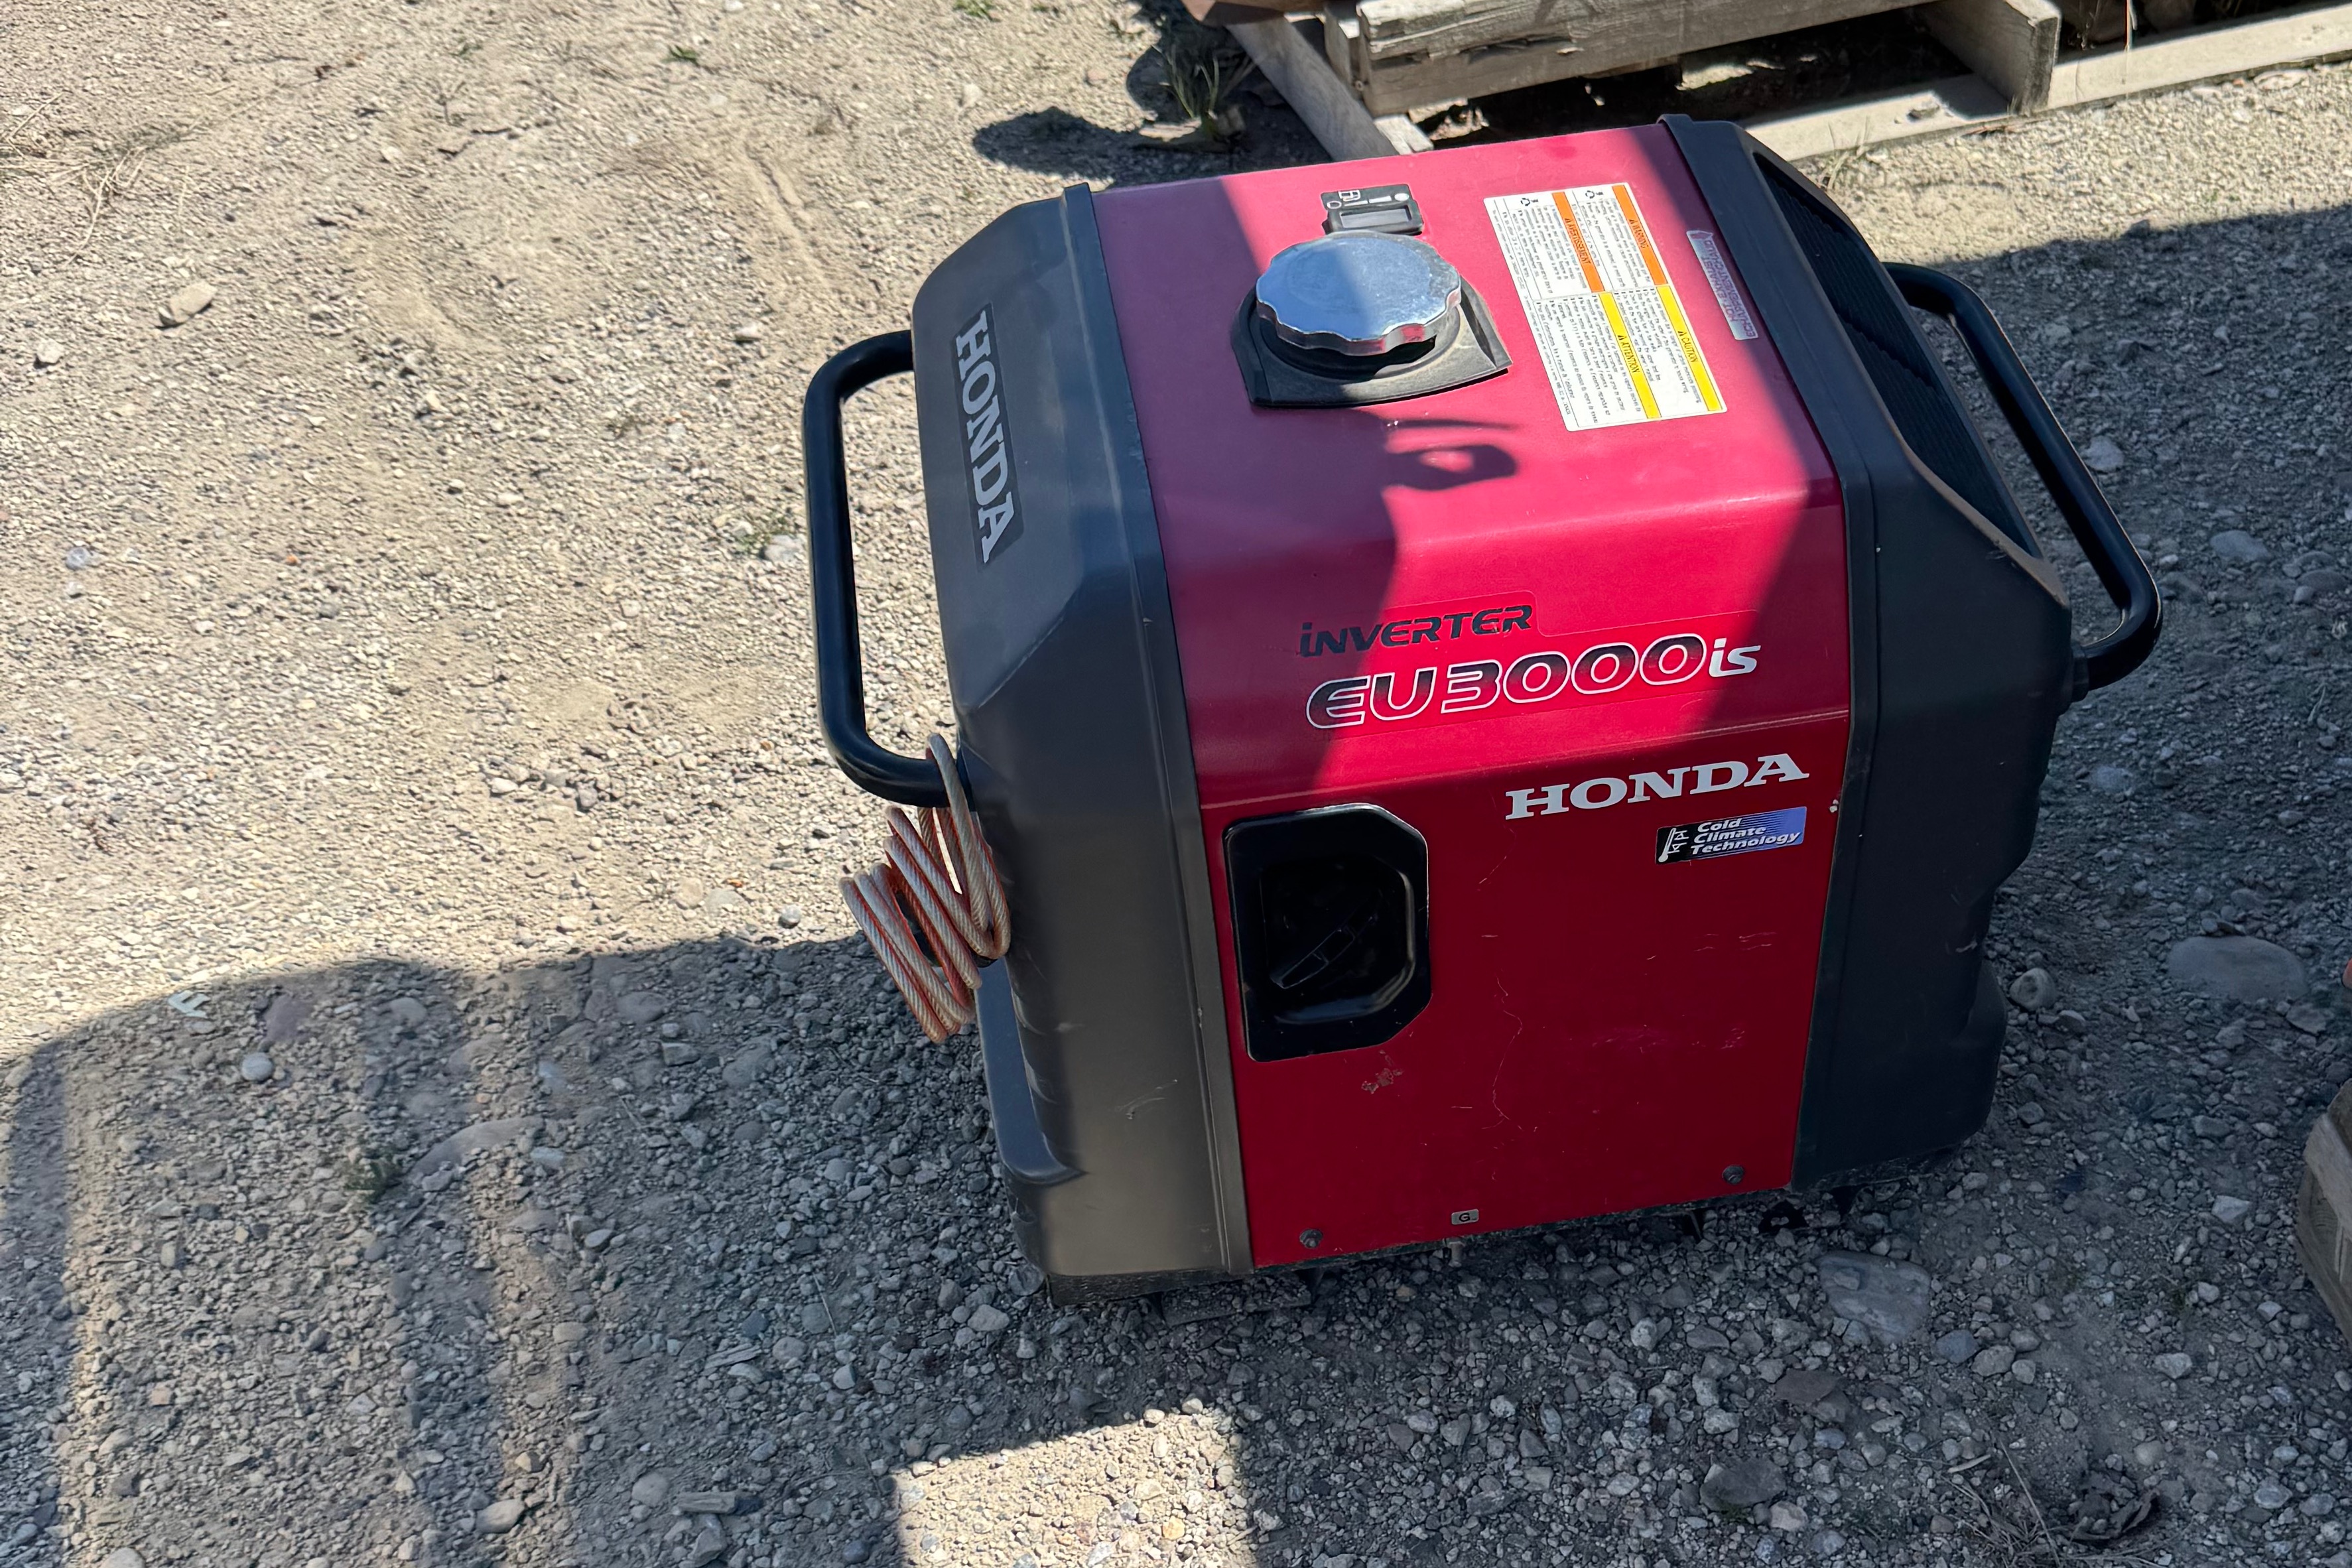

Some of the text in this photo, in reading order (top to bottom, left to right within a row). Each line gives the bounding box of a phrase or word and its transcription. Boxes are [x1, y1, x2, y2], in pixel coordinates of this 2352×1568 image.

[1620, 341, 1640, 373] ATTENTION
[1680, 337, 1699, 362] CAUTION
[956, 310, 1014, 564] HONDA
[1306, 633, 1761, 729] EU3000is
[1505, 753, 1809, 820] HONDA
[1693, 826, 1766, 844] Climate
[1697, 818, 1742, 832] Cold
[1691, 831, 1801, 855] Technology
[1459, 1212, 1470, 1222] G
